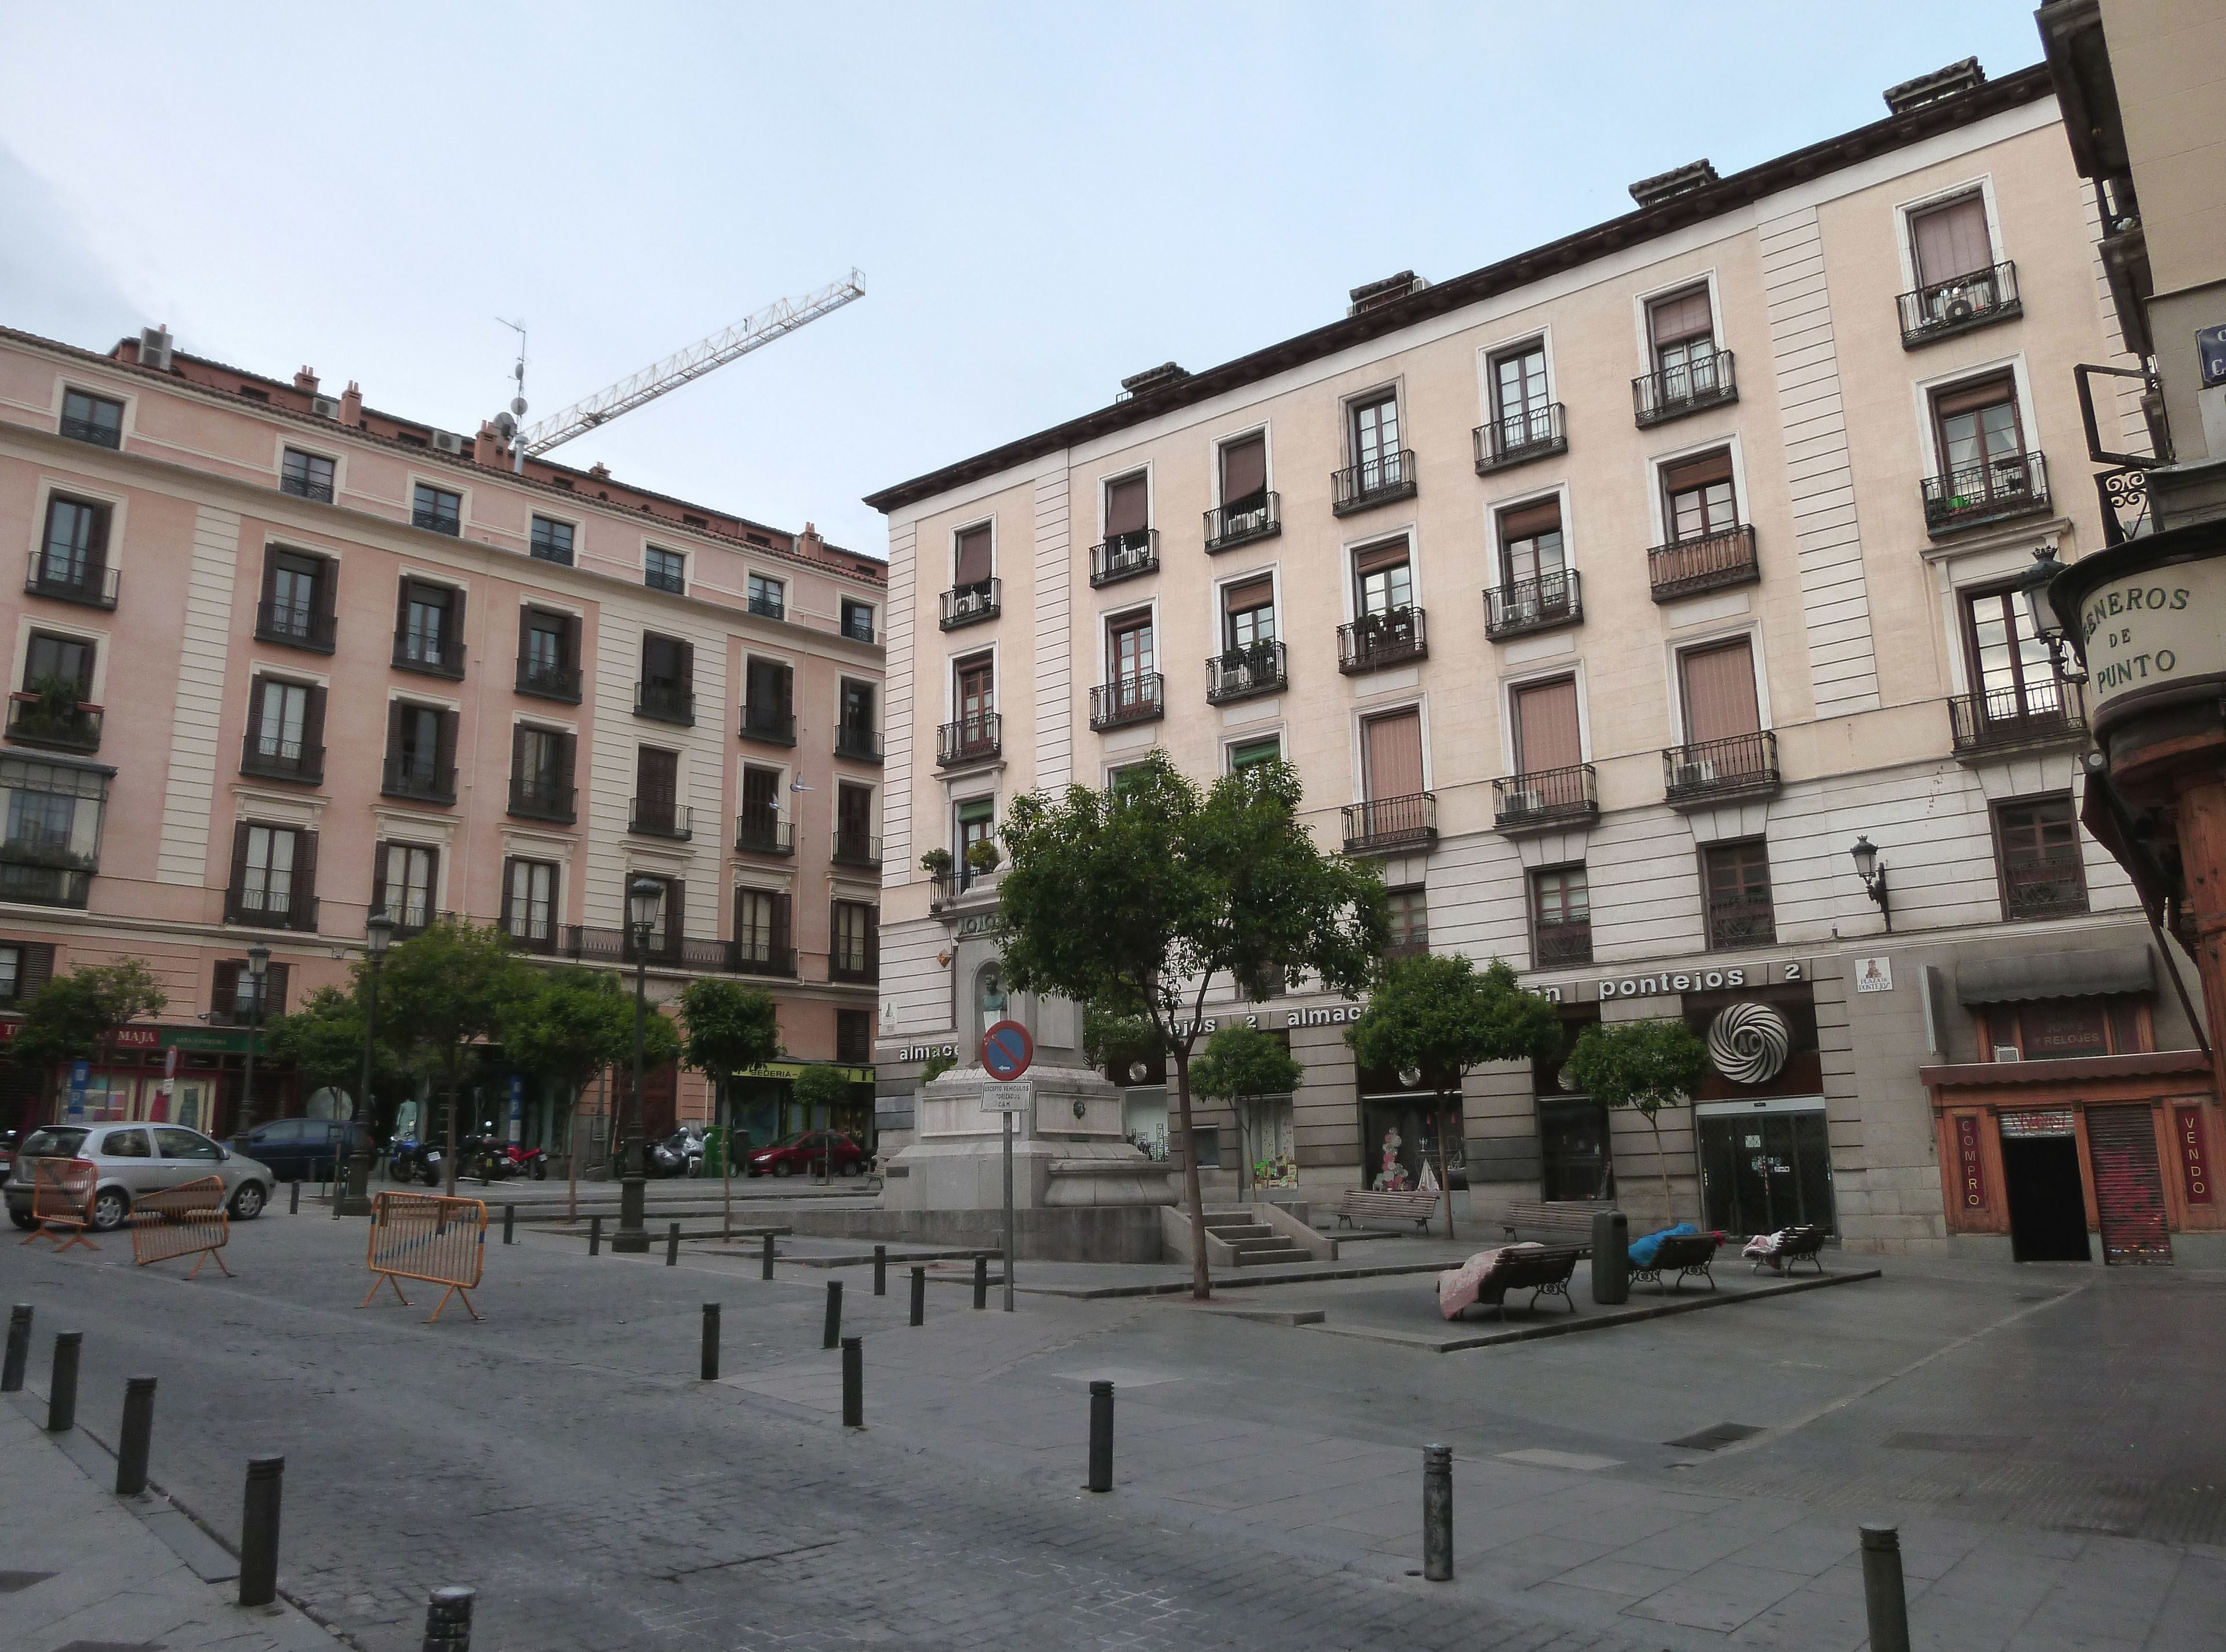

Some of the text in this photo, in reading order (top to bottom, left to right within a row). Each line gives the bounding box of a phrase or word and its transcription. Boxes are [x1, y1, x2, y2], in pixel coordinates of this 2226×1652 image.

[2109, 628, 2130, 647] DE
[2097, 650, 2175, 693] PUNTO
[1599, 969, 1743, 999] pontejos
[1785, 964, 1799, 980] 2
[1246, 1015, 1257, 1028] 2
[118, 1031, 155, 1043] MAJA
[2044, 1033, 2100, 1045] RELOJES
[1962, 1121, 1979, 1205] COMPRO
[2185, 1118, 2205, 1193] VENDO
